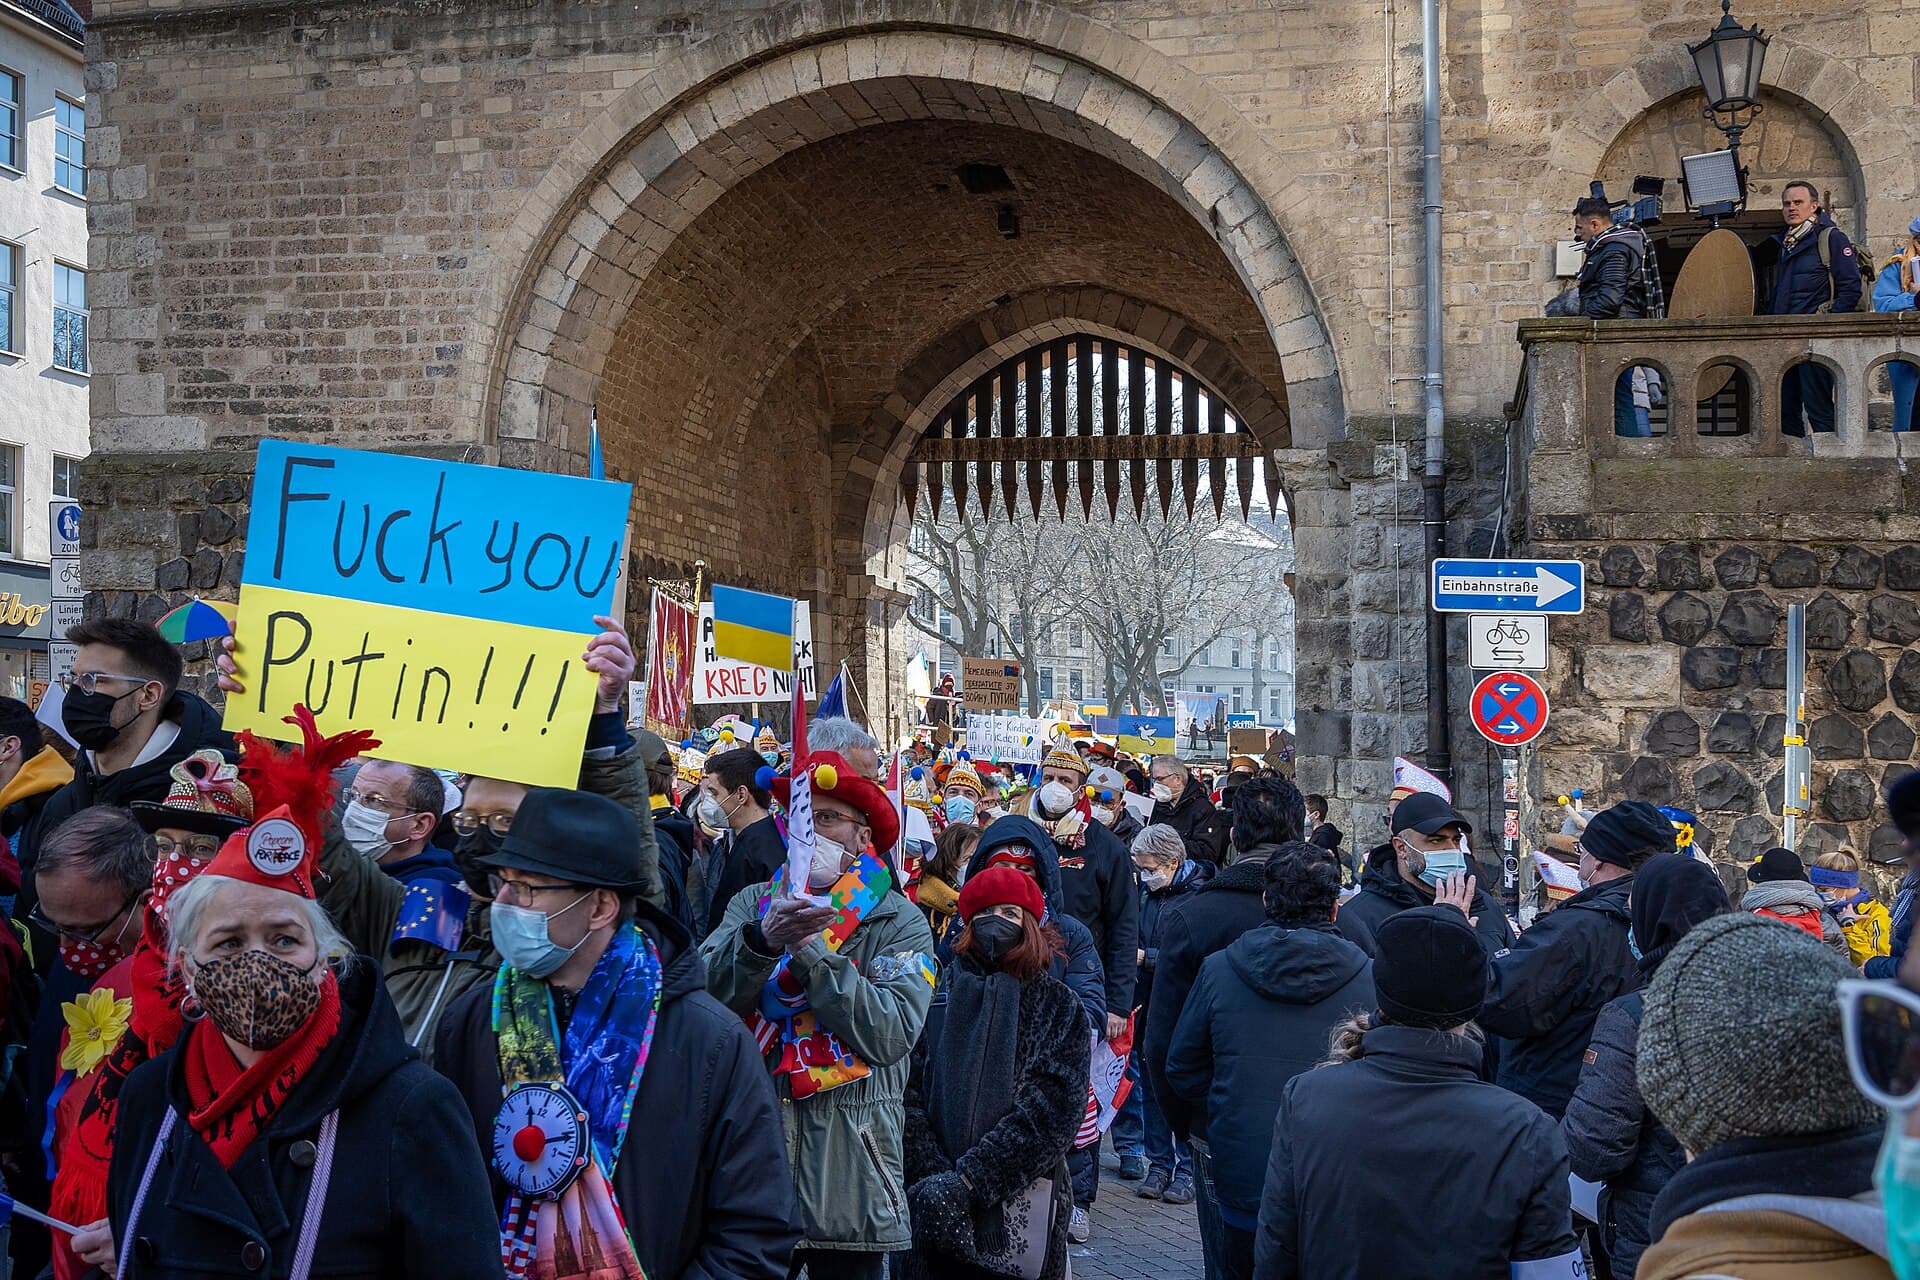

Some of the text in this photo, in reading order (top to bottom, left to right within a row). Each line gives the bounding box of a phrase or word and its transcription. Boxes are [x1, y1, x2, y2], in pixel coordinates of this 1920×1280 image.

[273, 456, 618, 598] Fuck you
[1442, 579, 1539, 593] Einbahnstraße
[53, 647, 78, 655] Lieferv
[258, 610, 569, 736] Putin!!!
[705, 666, 814, 698] KRIEG NIHT
[537, 1107, 548, 1118] 12
[551, 1147, 558, 1157] 3
